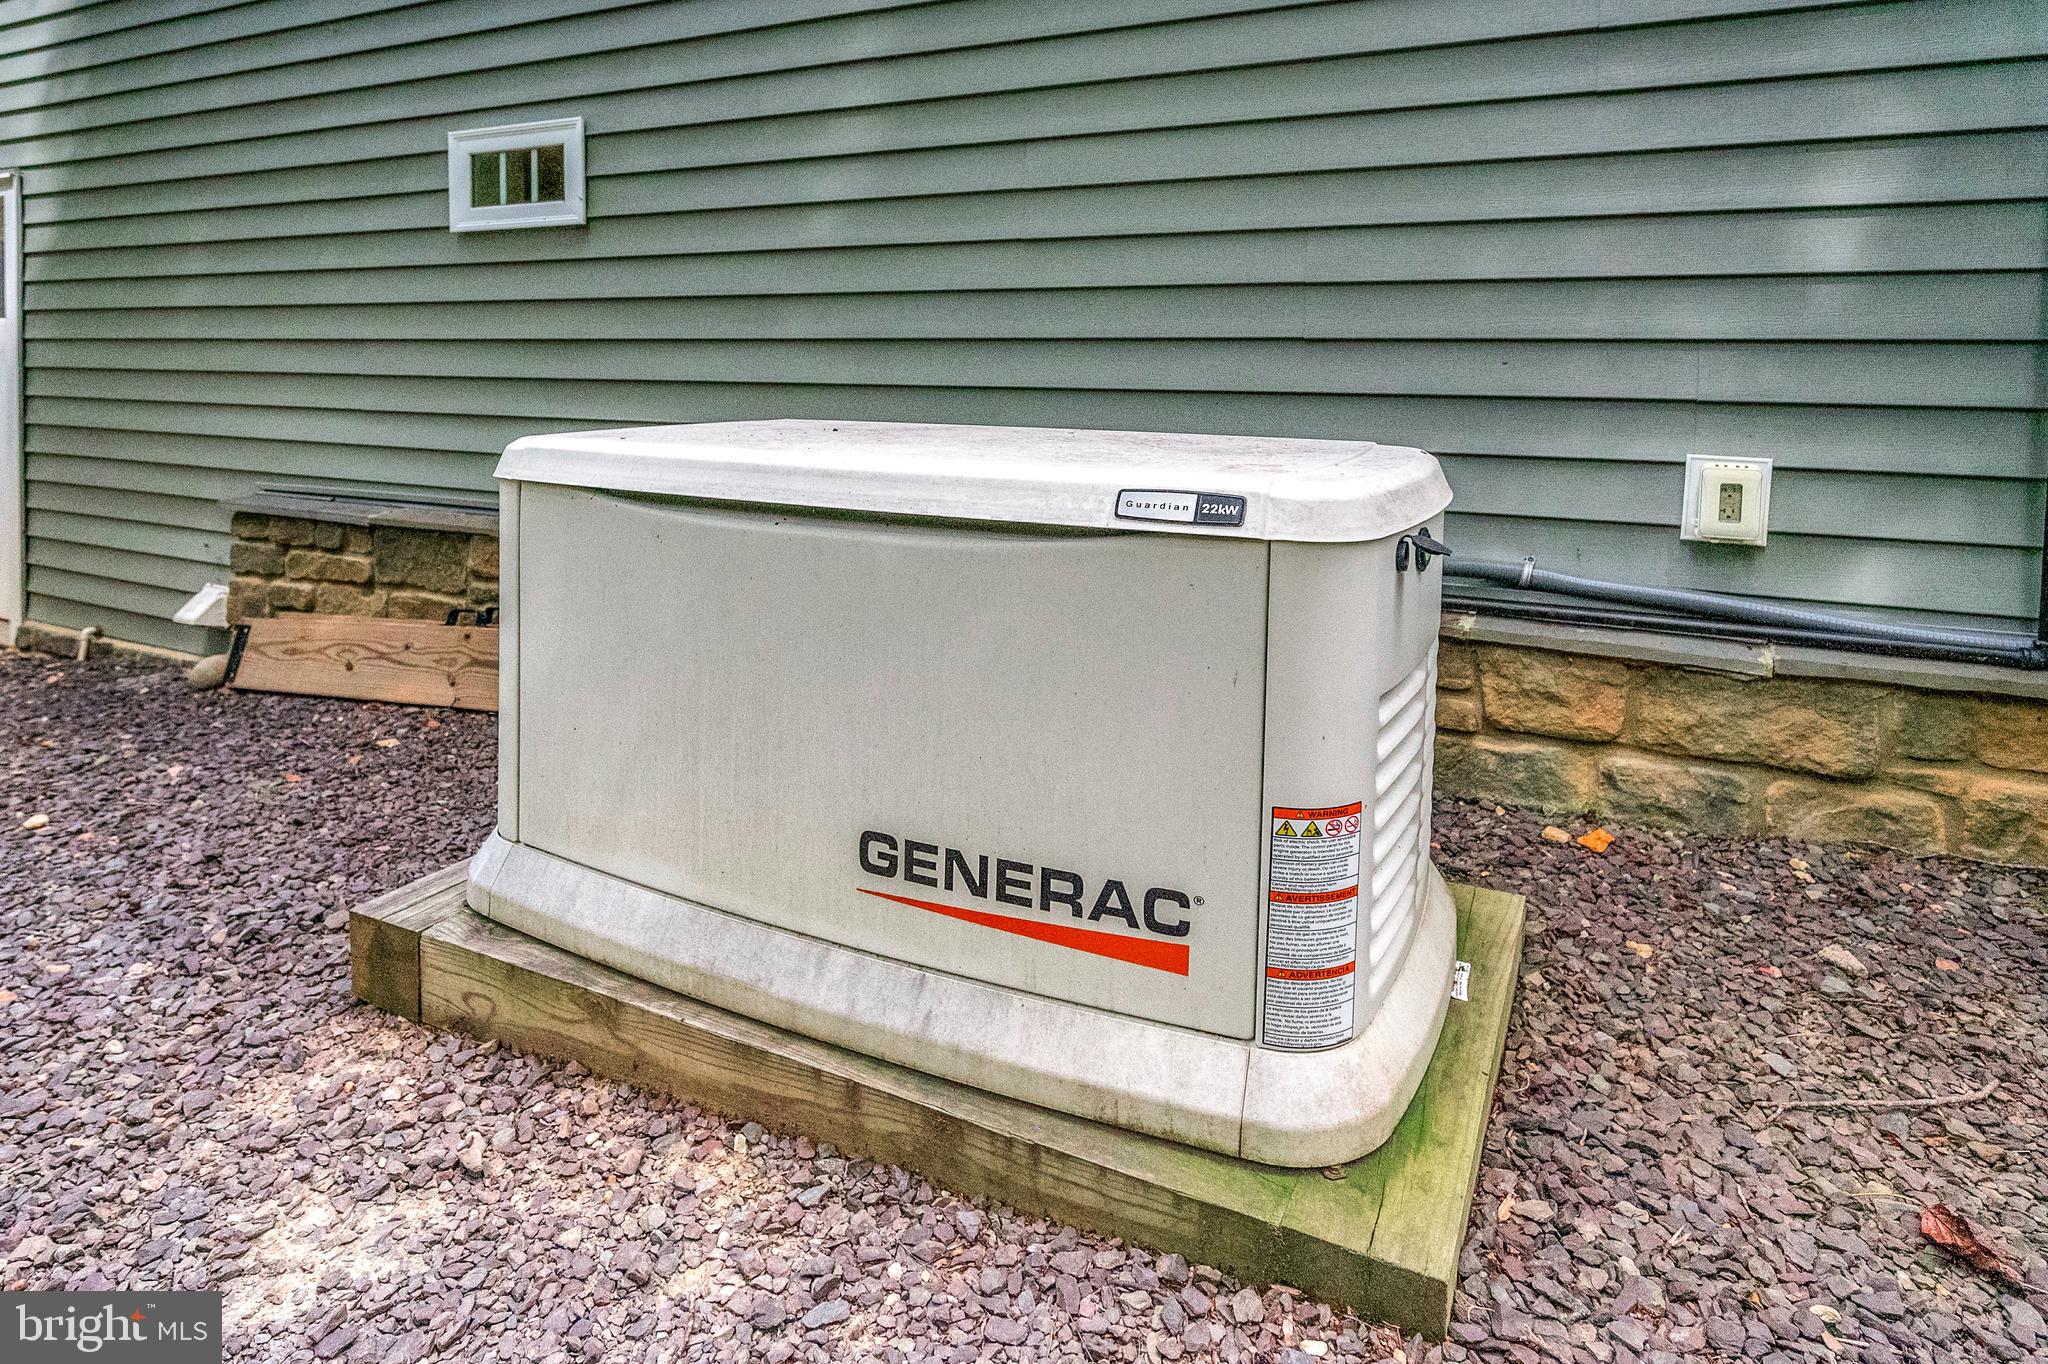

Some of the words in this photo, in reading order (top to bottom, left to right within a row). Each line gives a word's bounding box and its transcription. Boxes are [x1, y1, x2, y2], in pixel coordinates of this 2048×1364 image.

[1125, 500, 1189, 512] Guardian
[1201, 503, 1240, 516] 22kW
[1308, 808, 1348, 818] WARNING
[1286, 887, 1356, 902] AVERTISSEMENT
[1290, 966, 1350, 978] ADVERTENCIA
